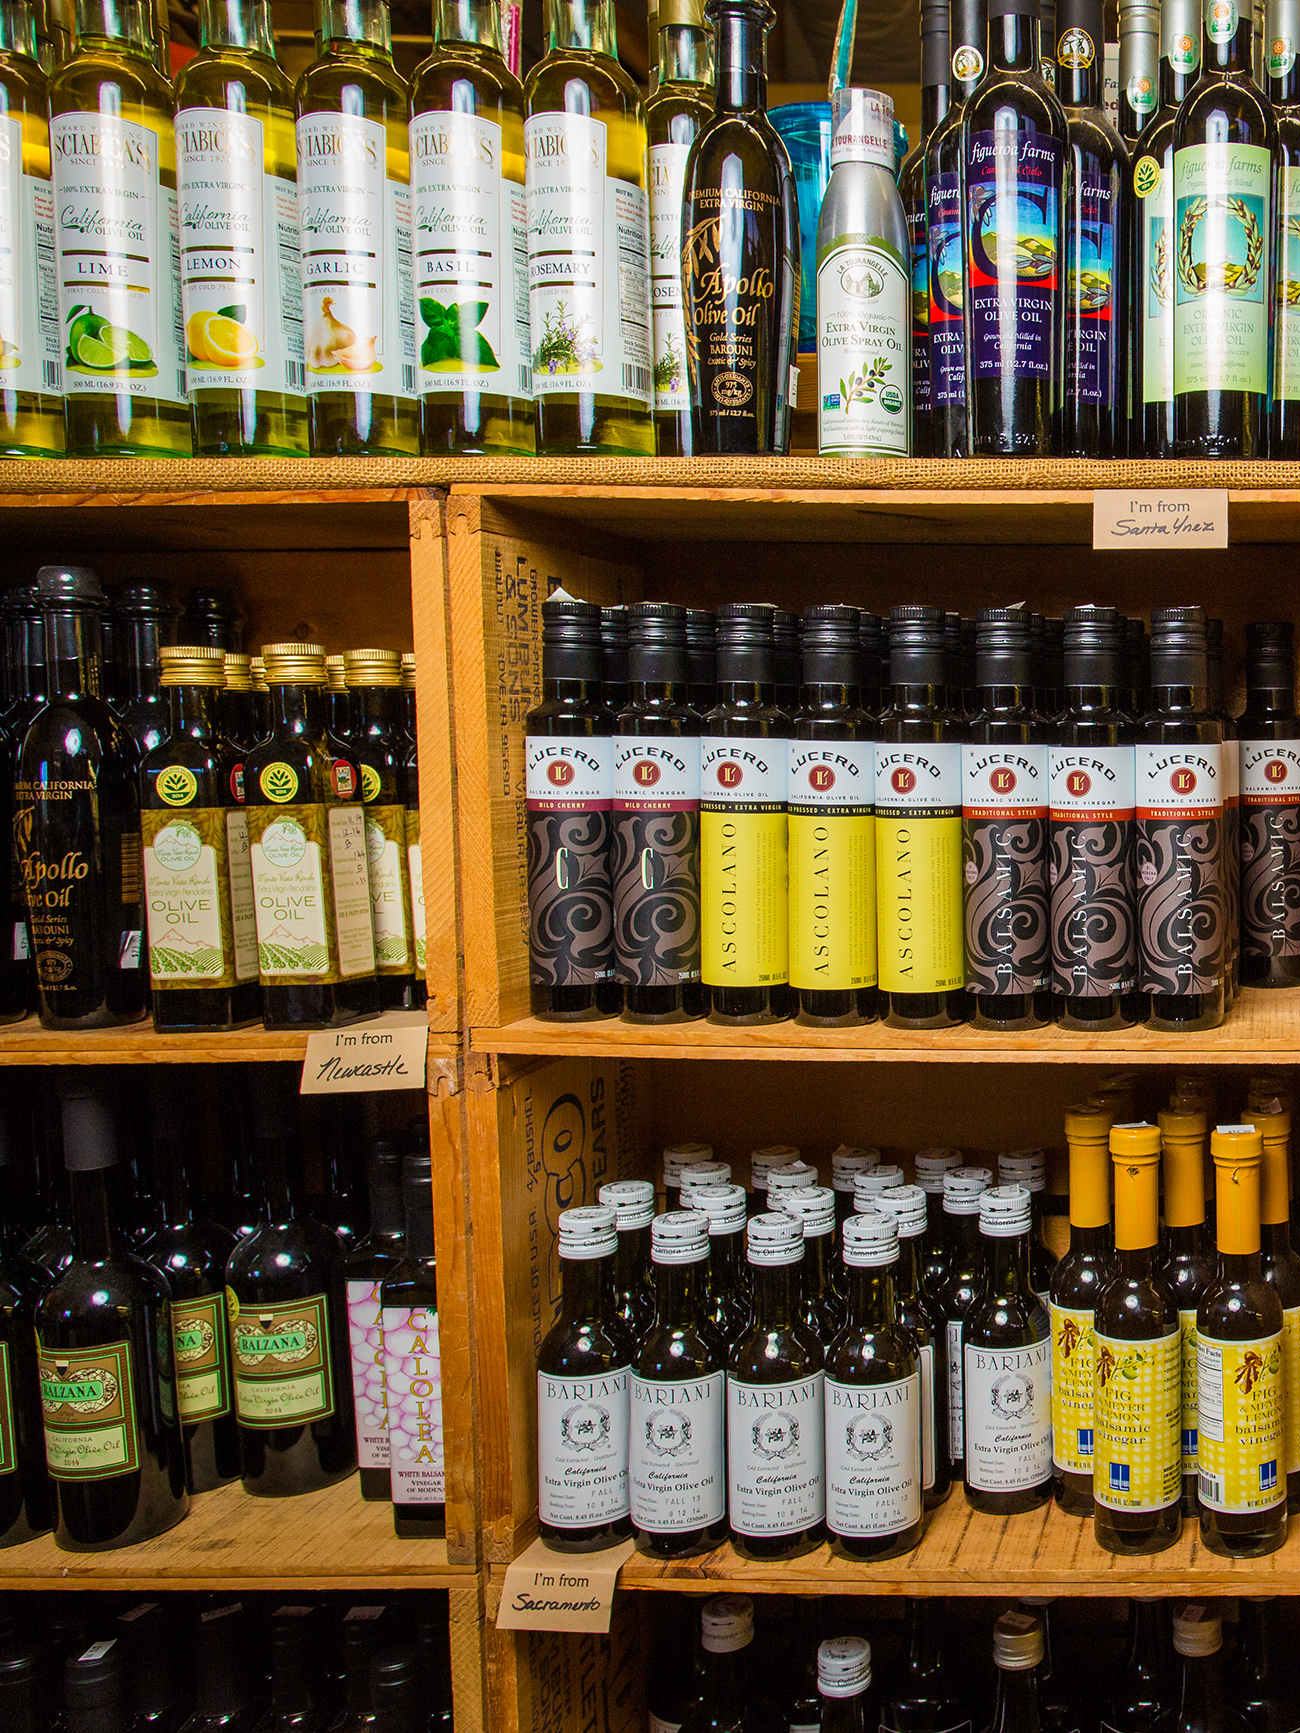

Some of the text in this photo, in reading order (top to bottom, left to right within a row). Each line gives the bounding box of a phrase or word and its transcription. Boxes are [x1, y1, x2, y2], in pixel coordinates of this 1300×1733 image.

[834, 134, 888, 149] TOURANGELLE
[970, 141, 1055, 164] figueroa farms
[1180, 156, 1262, 182] figueroa farms
[79, 186, 139, 199] EXTRA VIRGIN
[689, 188, 781, 206] PREMIUM CALIFORNIA
[700, 199, 764, 212] EXTRA VIRGIN
[60, 205, 145, 232] California
[95, 227, 145, 241] OLIVE OIL
[78, 262, 128, 277] LIME
[187, 258, 241, 270] LEMON
[306, 262, 363, 274] GARLIC
[427, 261, 474, 272] BASIL
[531, 262, 590, 276] ROSEMARY
[837, 257, 889, 278] LA TOURANGELLE
[693, 262, 773, 302] Apollo
[974, 298, 1052, 311] EXTRA VIRGIN
[694, 304, 757, 327] Olive Oil
[984, 310, 1042, 323] OLIVE OIL
[1193, 308, 1242, 320] ORGANIC
[710, 344, 753, 356] BAROUNI
[1129, 499, 1191, 514] I'm from
[528, 746, 599, 772] LUCERO
[702, 748, 768, 775] LUCERO
[969, 752, 1038, 779] LUCERO
[20, 852, 88, 882] Apollo
[556, 847, 569, 890] C
[148, 876, 170, 886] Monte
[190, 875, 213, 886] Ranch
[165, 888, 181, 897] Virgin
[182, 888, 213, 896] Pendolino
[721, 822, 737, 973] ASCOLANO
[151, 900, 211, 912] OLIVE
[997, 833, 1013, 976] BALSAMIC
[165, 912, 199, 924] OIL
[335, 1031, 393, 1046] I'm from
[316, 1054, 409, 1081] Newcastle
[242, 1336, 301, 1351] BALZANA
[408, 1313, 437, 1465] CALOLEA
[737, 1383, 815, 1410] BARIANI
[1104, 1386, 1132, 1401] FIG
[1107, 1402, 1145, 1412] MEYER
[1095, 1416, 1151, 1433] balsamic
[1100, 1413, 1140, 1422] LEMON
[1098, 1430, 1146, 1445] vinegar
[756, 1473, 798, 1485] California
[736, 1477, 820, 1497] Extra Virgin Olive Oil
[534, 1573, 589, 1588] I'm from
[511, 1593, 601, 1613] Sacramento
